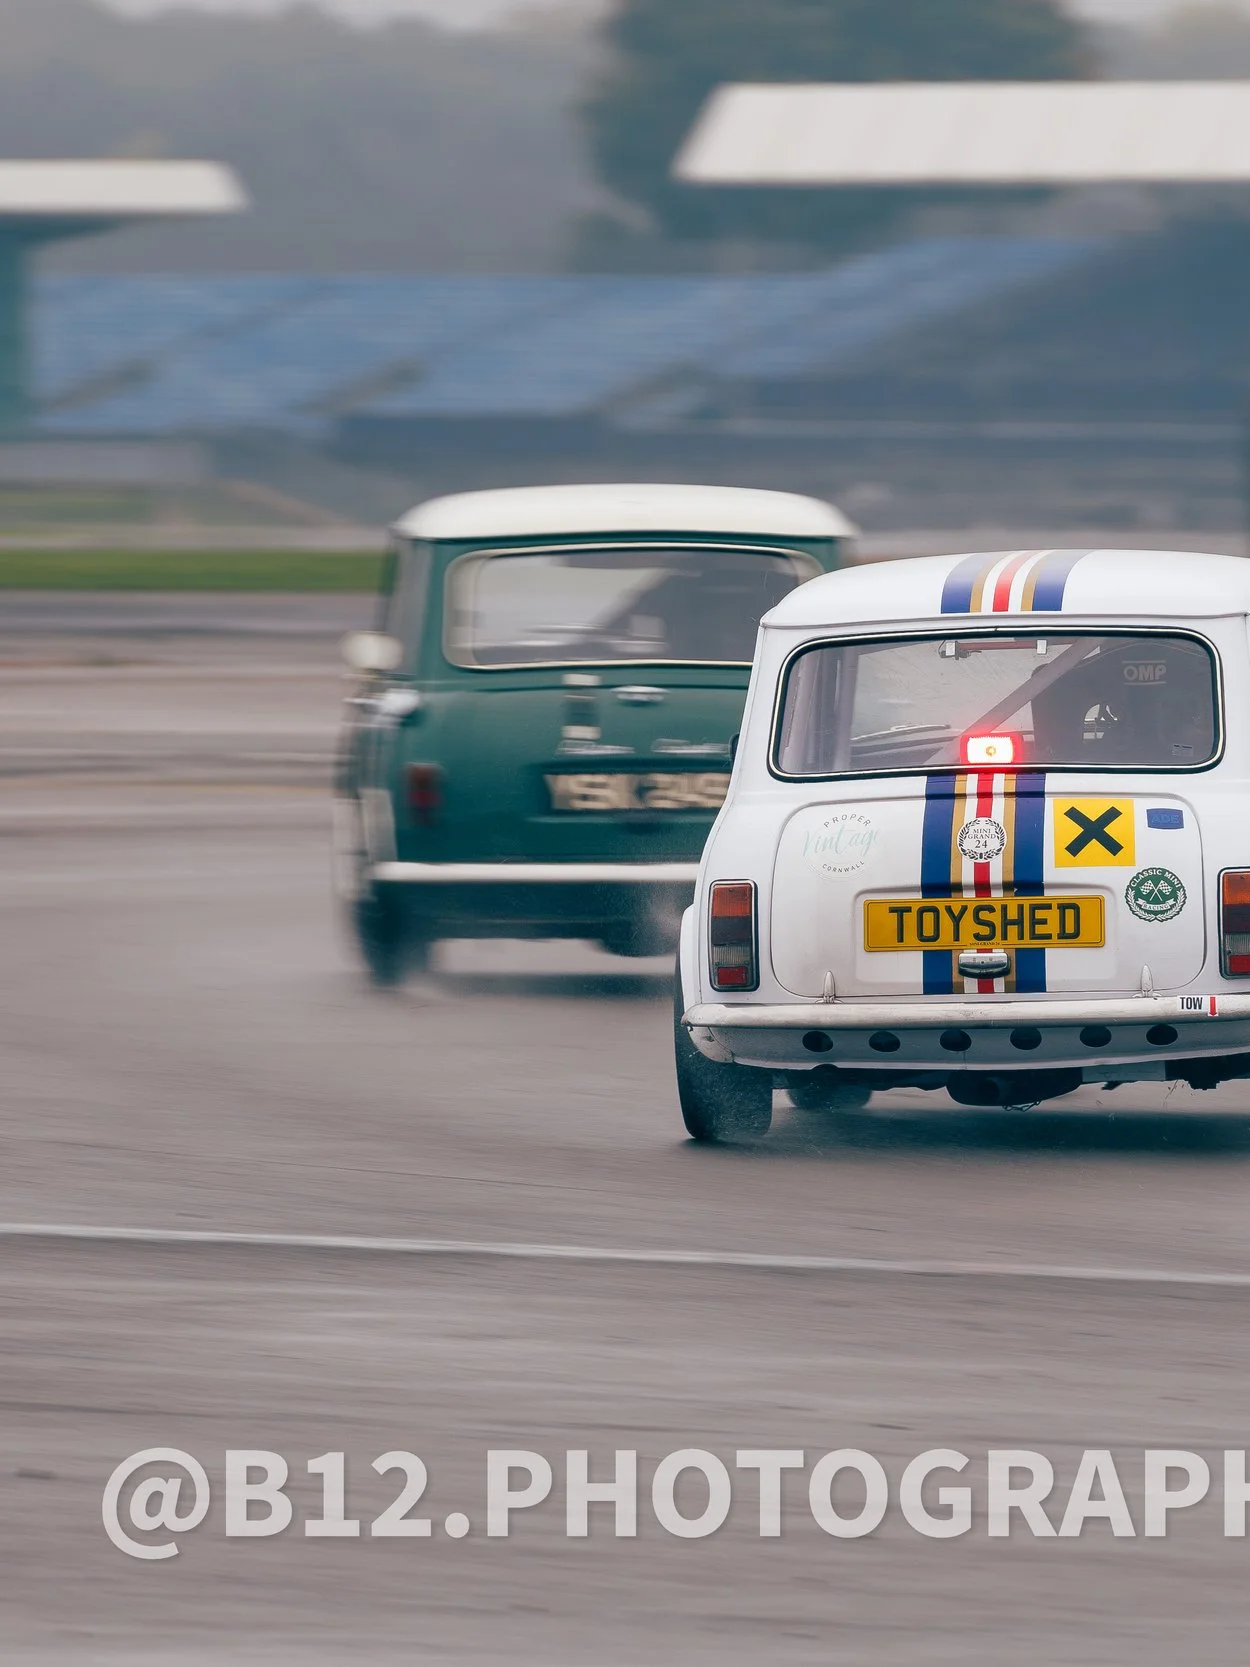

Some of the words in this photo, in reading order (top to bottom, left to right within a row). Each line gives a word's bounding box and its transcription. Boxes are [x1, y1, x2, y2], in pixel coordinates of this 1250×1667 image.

[1123, 665, 1167, 681] OMP
[823, 813, 871, 828] PROPER
[802, 824, 881, 857] Vintage
[975, 840, 987, 849] 24
[822, 860, 864, 873] CORNWALL
[1130, 869, 1163, 887] CLASSIC
[1163, 871, 1181, 888] MINI
[1142, 902, 1170, 911] RACING
[888, 902, 1081, 943] TOYSHED
[1180, 997, 1203, 1010] TOW
